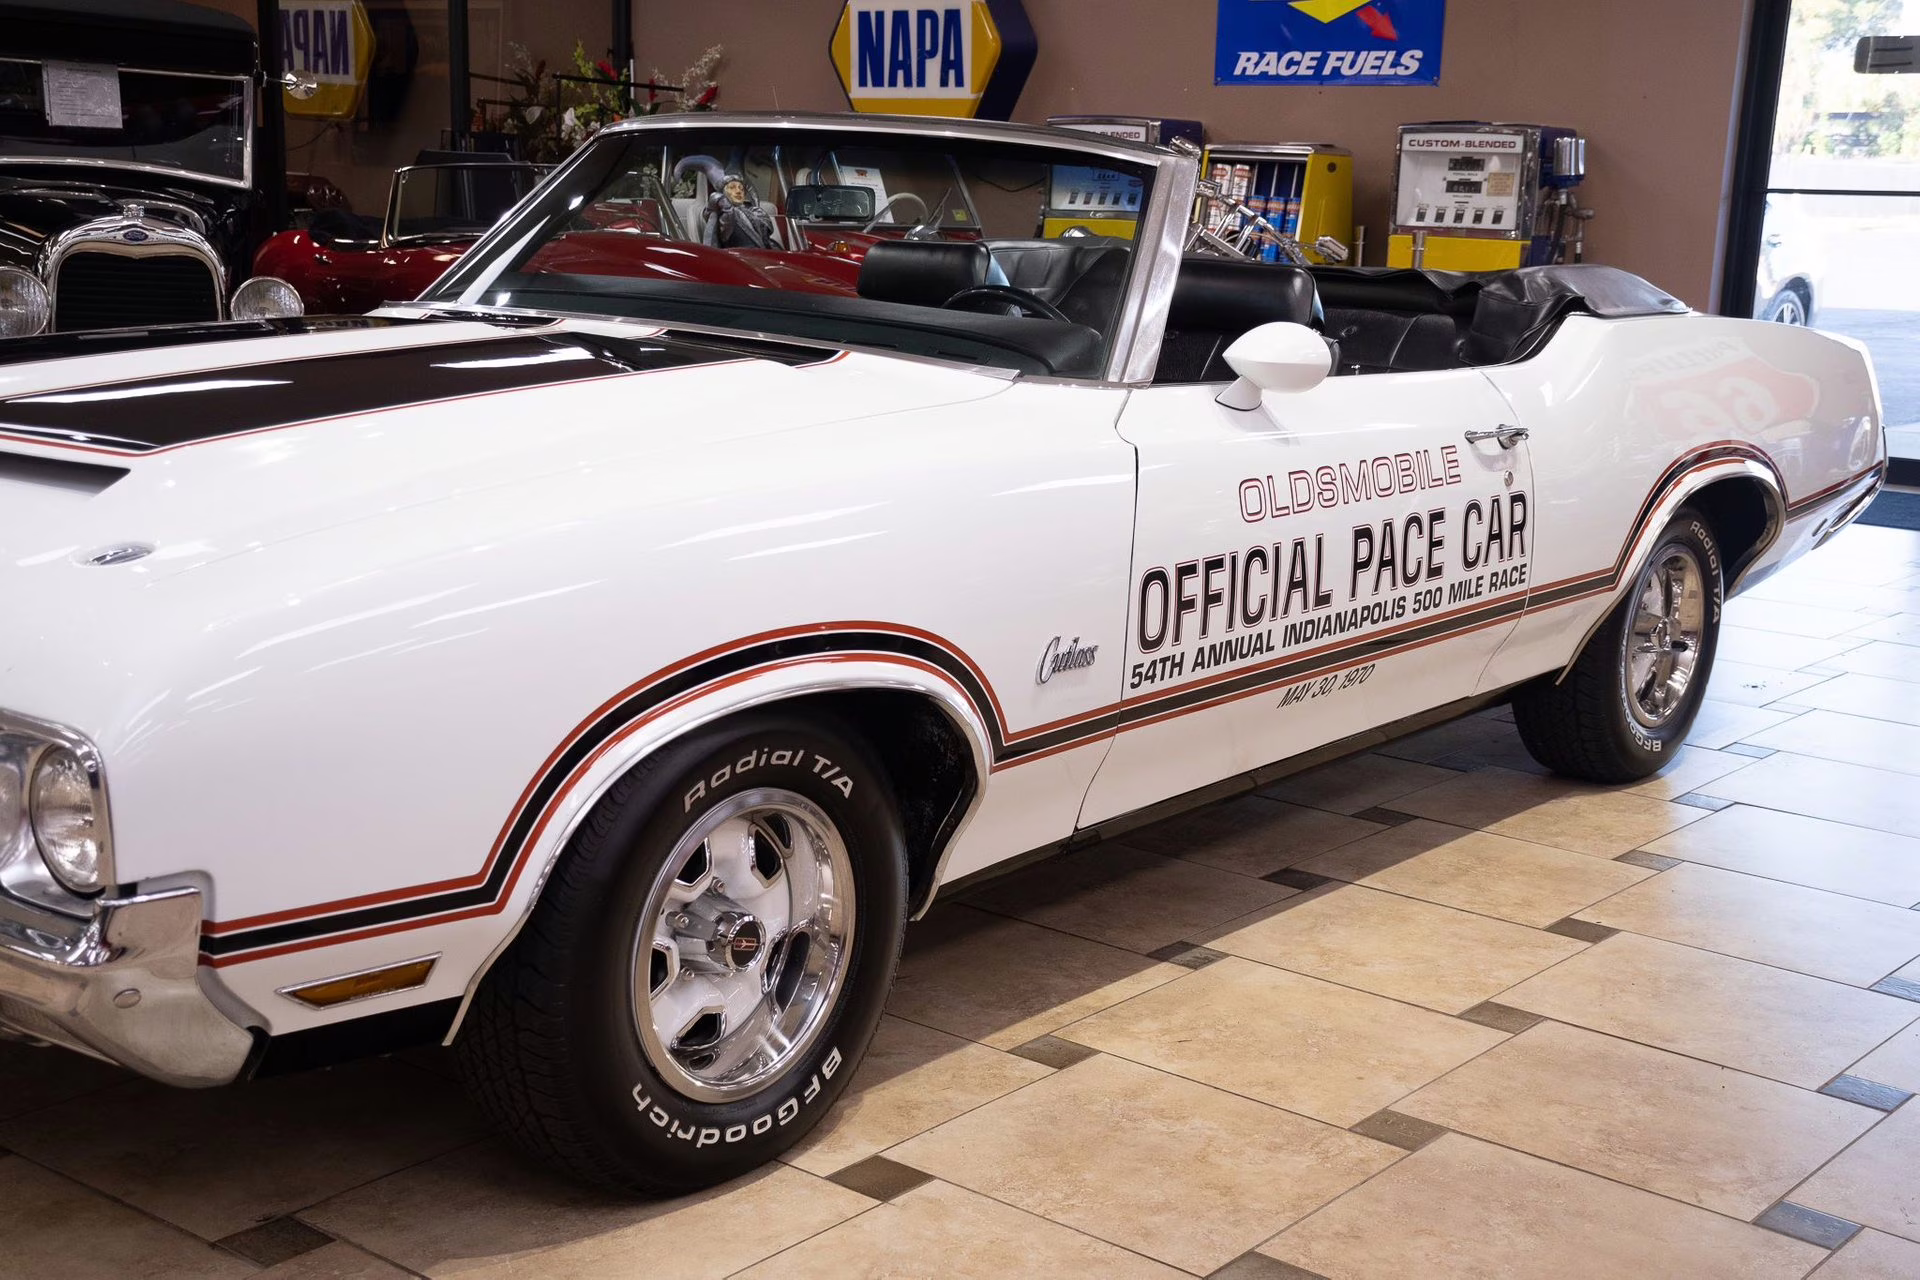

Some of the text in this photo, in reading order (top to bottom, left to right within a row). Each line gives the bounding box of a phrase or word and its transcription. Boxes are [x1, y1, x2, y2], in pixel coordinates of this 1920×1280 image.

[857, 9, 965, 88] NAPA
[1233, 49, 1424, 76] RACE FUELS
[1408, 139, 1517, 149] CUSTOM-BLENDED
[1238, 445, 1462, 523] OLDSMOBILE
[1137, 490, 1528, 654] OFFICIAL PACE CAR
[1690, 521, 1720, 624] Radial T/A
[1036, 635, 1099, 685] Cutlass
[1130, 563, 1528, 690] 54TH ANNUAL INDIANAPOLIS 500 MILE RACE
[1276, 663, 1376, 709] MAY 30, 1970
[684, 748, 853, 814] Radial T/A
